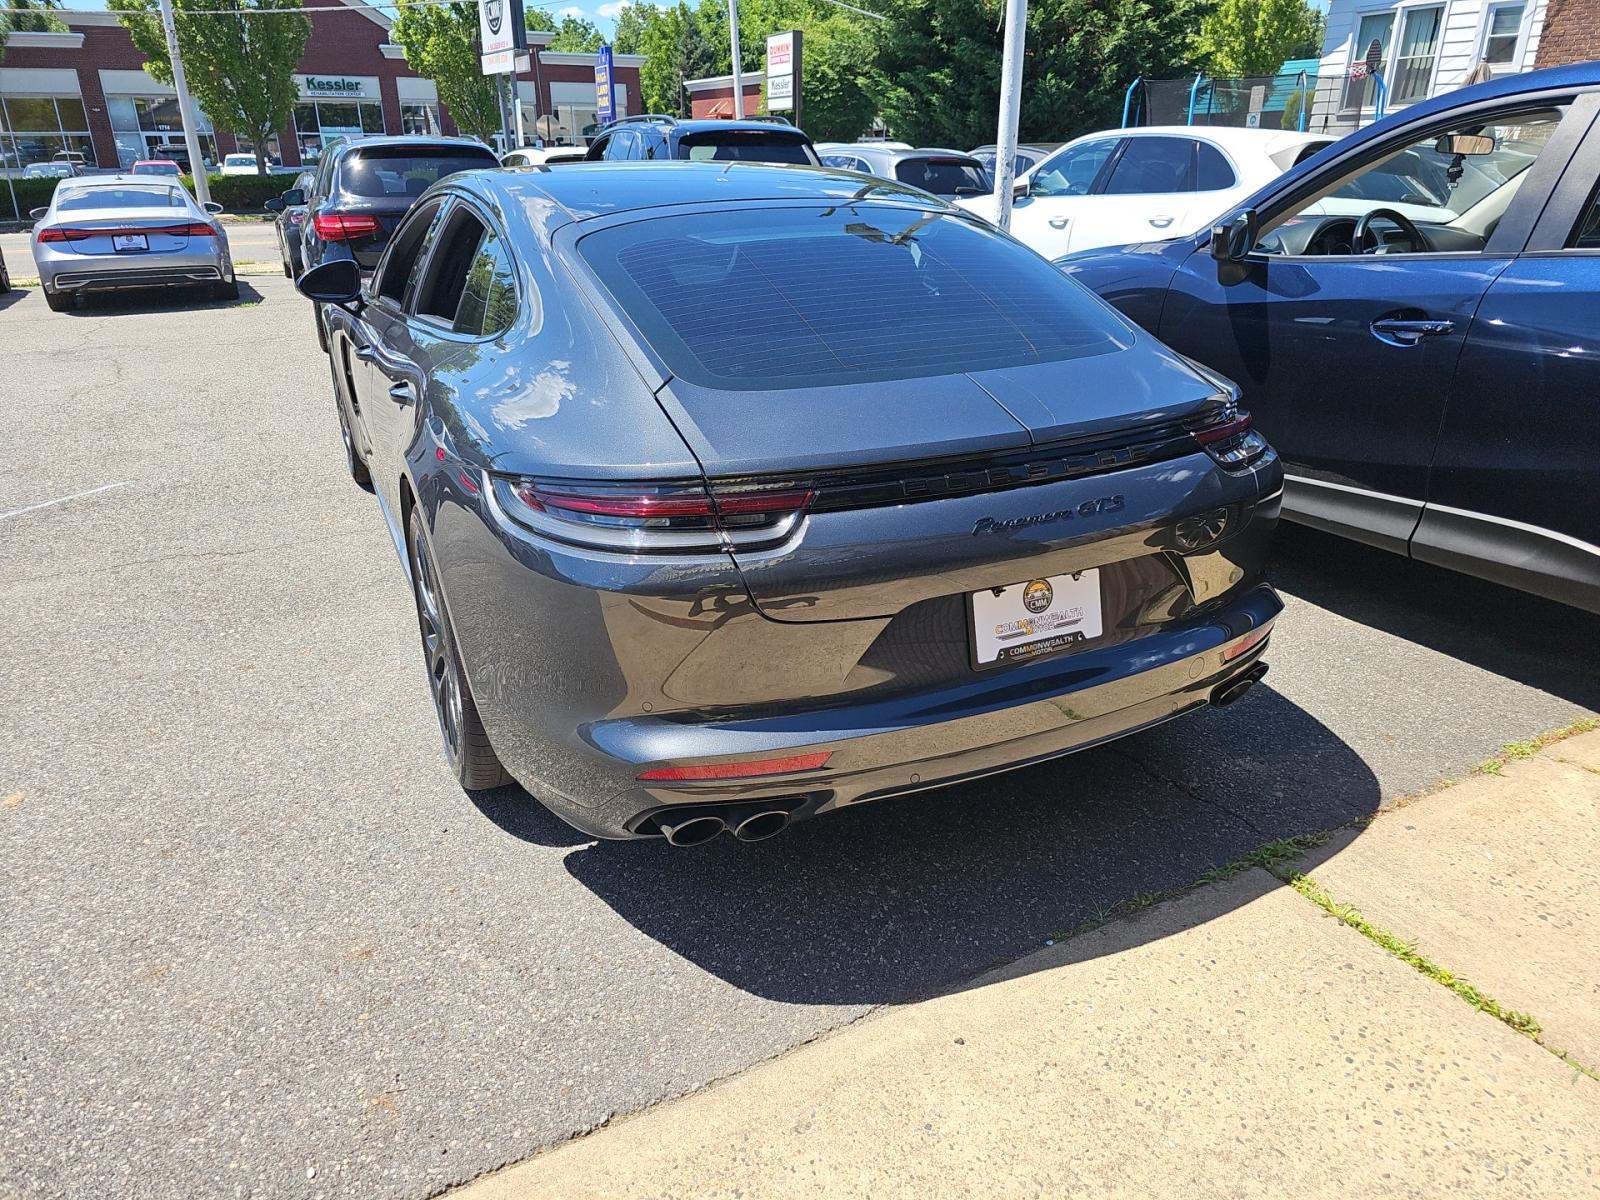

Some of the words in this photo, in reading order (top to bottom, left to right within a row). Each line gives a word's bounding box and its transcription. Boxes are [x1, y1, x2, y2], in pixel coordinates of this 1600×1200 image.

[306, 77, 361, 91] Kessler
[970, 507, 1074, 537] Panamera
[1077, 494, 1125, 516] GTS
[995, 606, 1084, 634] COMMONWEALTH
[1009, 635, 1074, 656] COMMONWEALTH
[1031, 646, 1054, 657] MOTOR
